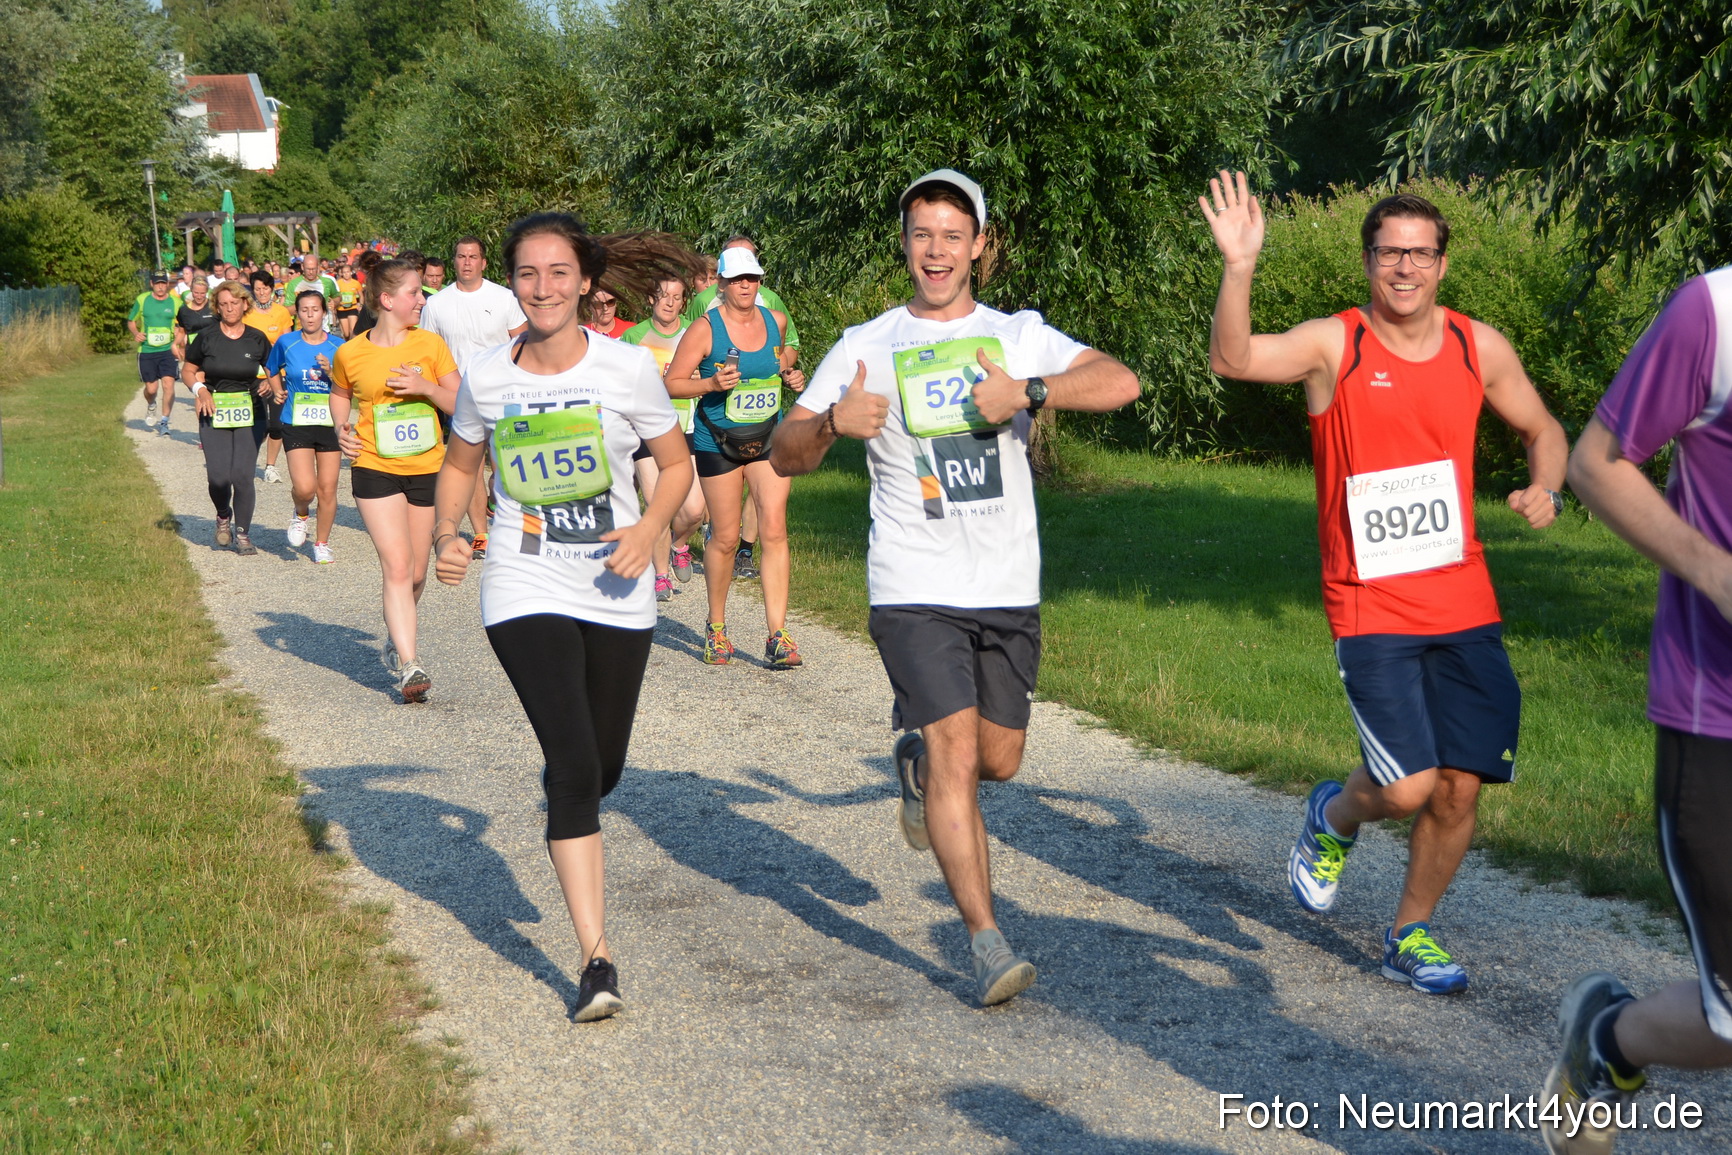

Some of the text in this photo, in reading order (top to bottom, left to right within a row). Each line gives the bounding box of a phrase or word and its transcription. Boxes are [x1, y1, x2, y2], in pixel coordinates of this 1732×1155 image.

[302, 369, 307, 380] I
[520, 391, 542, 399] NEUE
[547, 387, 602, 397] WOHNFORMEL
[926, 373, 984, 409] 52
[733, 392, 776, 409] 1283
[215, 408, 251, 422] 5189
[302, 407, 327, 420] 488
[394, 423, 419, 442] 66
[508, 429, 543, 440] firmenlauf
[985, 448, 996, 456] NM
[510, 445, 597, 483] 1155
[945, 457, 985, 488] RW
[556, 482, 577, 490] Mantel
[1351, 472, 1437, 498] df-sports
[595, 495, 607, 505] NM
[551, 504, 596, 530] RW
[1364, 498, 1450, 544] 8920
[1361, 536, 1459, 560] www.df-sports.de
